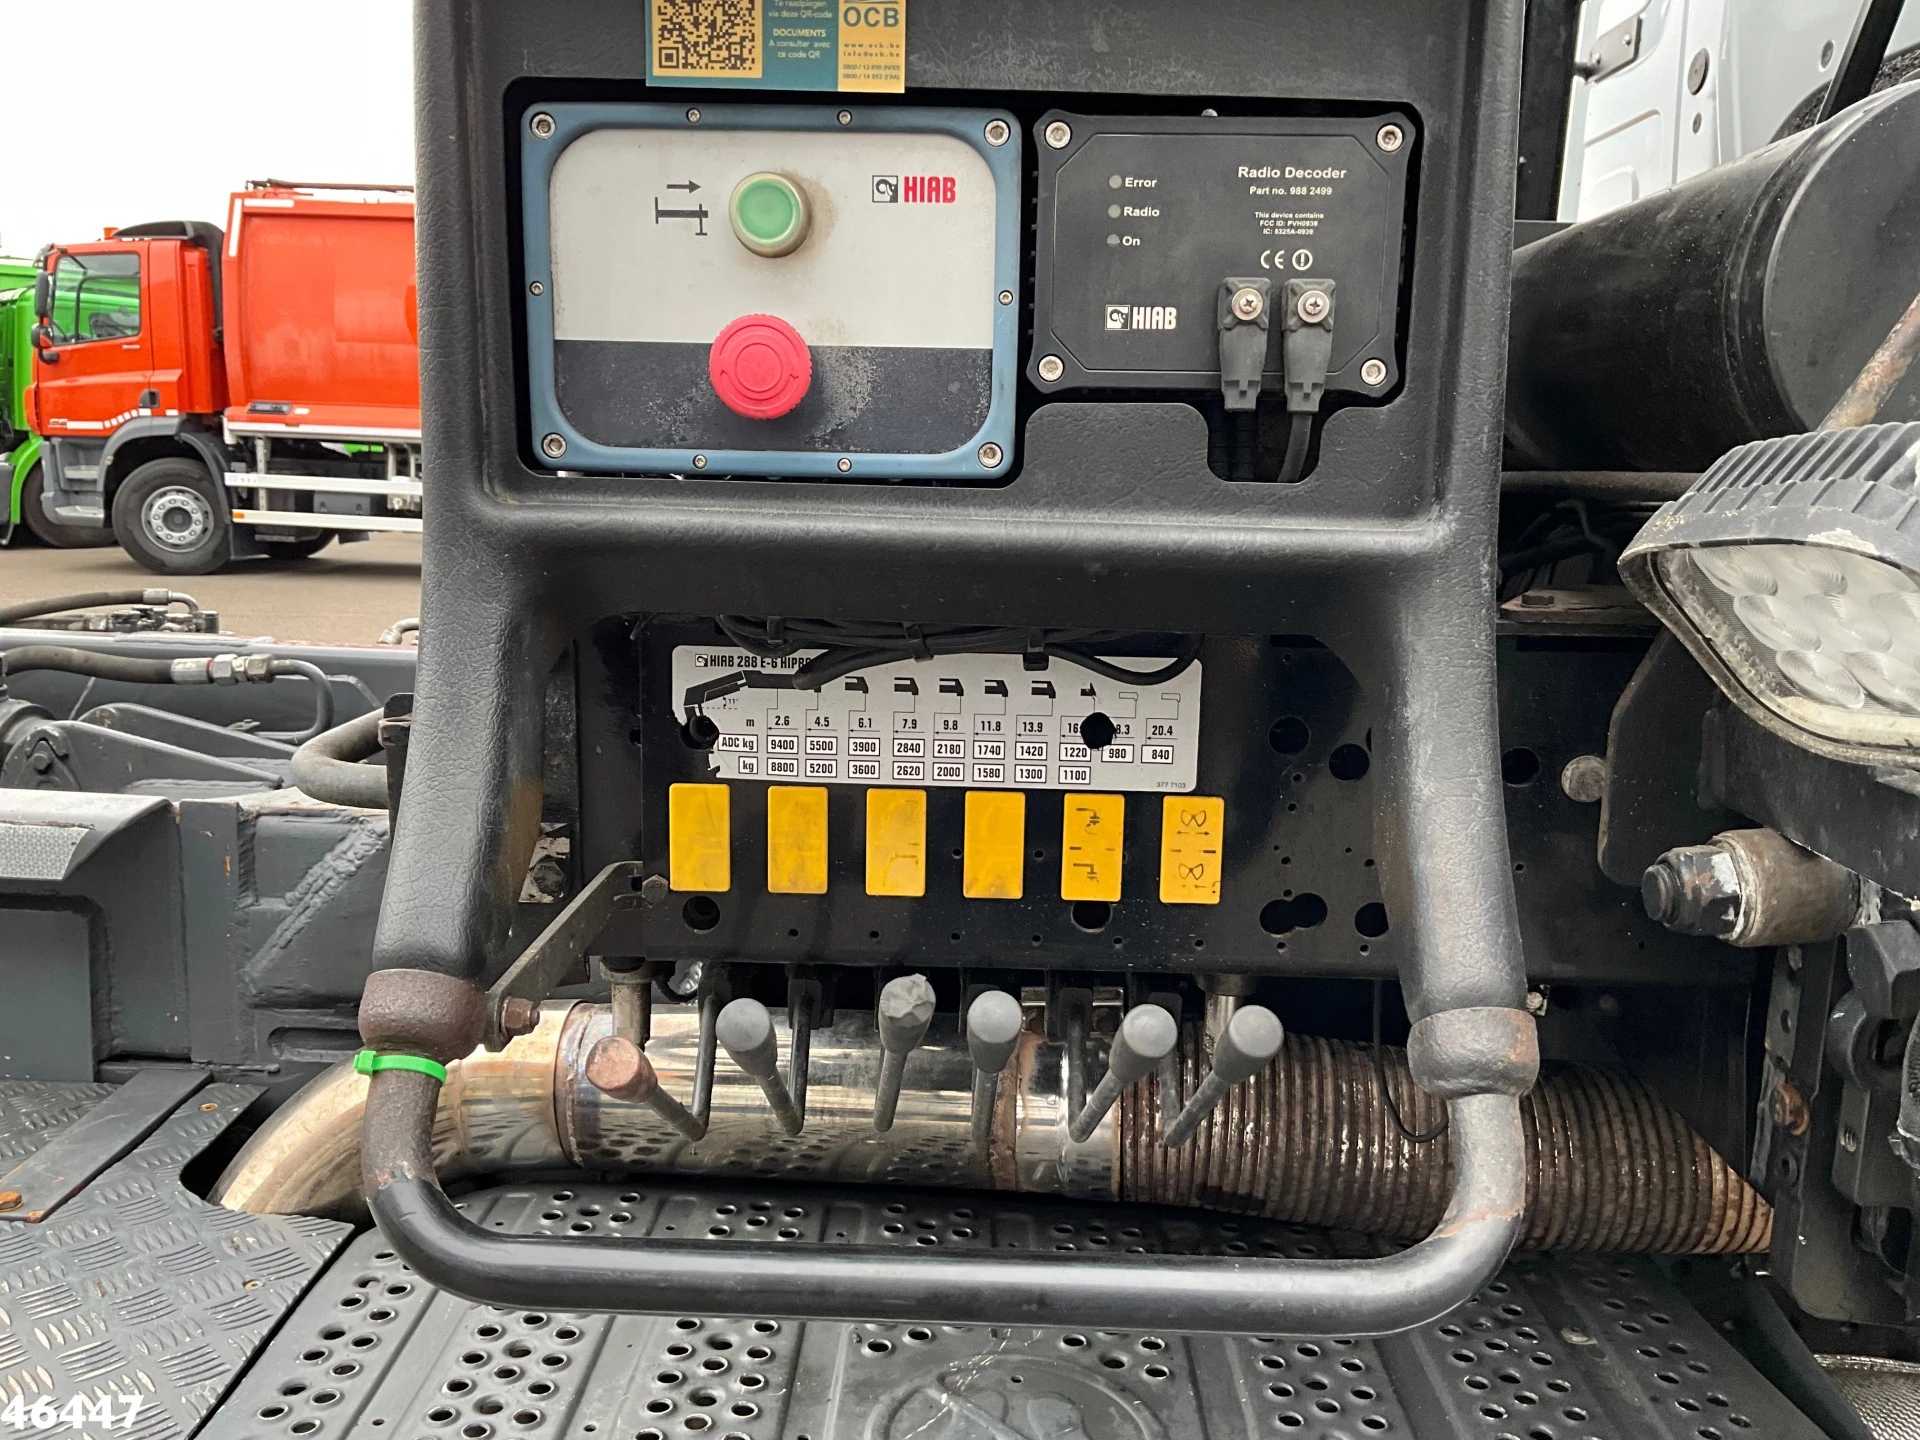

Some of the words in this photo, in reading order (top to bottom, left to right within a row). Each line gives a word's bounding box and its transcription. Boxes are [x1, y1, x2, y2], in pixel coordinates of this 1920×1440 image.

[843, 6, 899, 27] OCB
[773, 28, 826, 37] DOCUMENTS
[808, 50, 820, 58] QR
[1238, 166, 1280, 178] Radio
[1284, 166, 1347, 178] Decoder
[1124, 177, 1157, 188] Error
[904, 176, 956, 204] HIAB
[1250, 186, 1269, 195] Part
[1290, 186, 1307, 195] 988
[1309, 186, 1332, 195] 2499
[1124, 207, 1160, 217] Radio
[1122, 236, 1141, 246] On
[1260, 250, 1284, 269] CE
[1132, 307, 1177, 329] HIAB
[710, 655, 734, 667] HIAB
[737, 656, 757, 668] 288
[761, 657, 777, 668] E-6
[746, 718, 754, 727] m
[775, 715, 790, 726] 2.6
[815, 716, 830, 727] 4.5
[858, 718, 872, 728] 6.1
[902, 718, 917, 729] 7.9
[943, 720, 958, 730] 9.8
[981, 721, 1001, 732] 11.8
[1022, 722, 1043, 732] 13.9
[1152, 725, 1173, 735] 20.4
[722, 737, 739, 748] ADC
[742, 738, 754, 750] kg
[771, 740, 794, 750] 9400
[810, 740, 833, 751] 5500
[852, 741, 876, 752] 3900
[897, 742, 920, 753] 2840
[937, 744, 960, 755] 2180
[977, 745, 1001, 756] 1740
[1020, 746, 1043, 757] 1420
[1064, 746, 1087, 757] 1220
[1108, 748, 1126, 759] 980
[1152, 749, 1170, 760] 840
[742, 760, 754, 772] kg
[771, 762, 794, 773] 8800
[810, 763, 833, 774] 5200
[852, 764, 876, 775] 3600
[896, 765, 920, 776] 2620
[937, 767, 960, 777] 2000
[977, 767, 1000, 778] 1580
[1020, 768, 1043, 779] 1300
[1064, 770, 1086, 780] 1100
